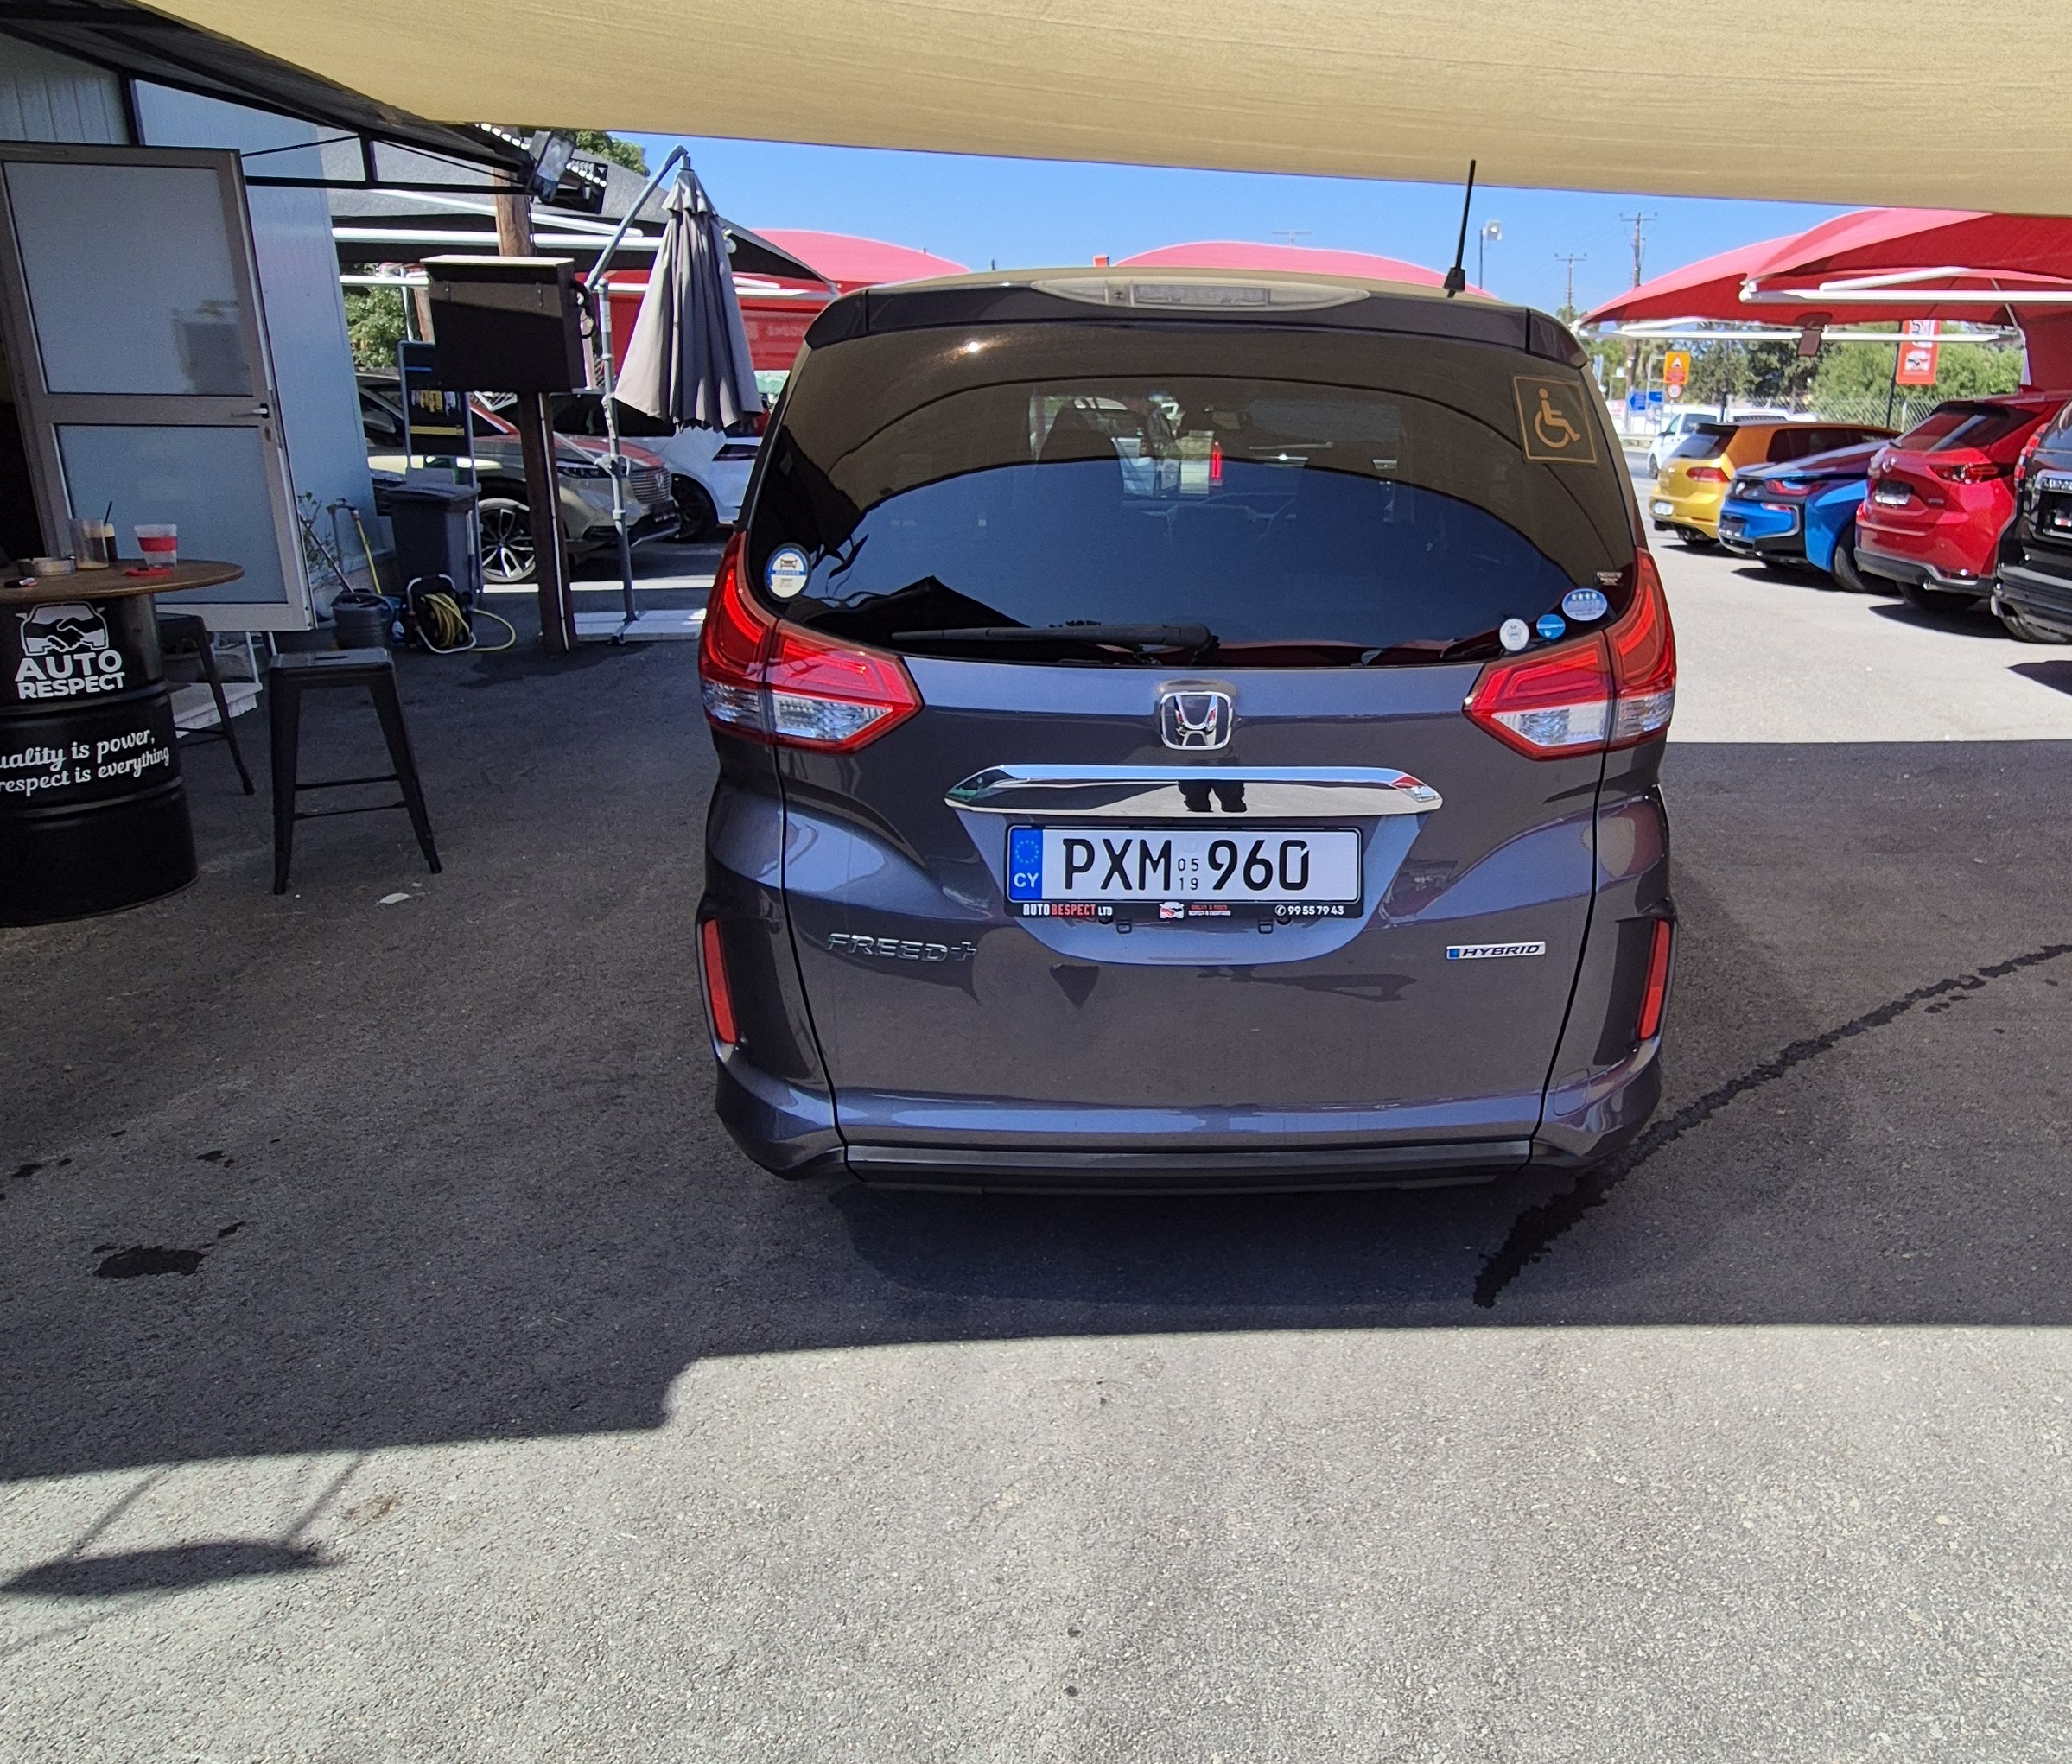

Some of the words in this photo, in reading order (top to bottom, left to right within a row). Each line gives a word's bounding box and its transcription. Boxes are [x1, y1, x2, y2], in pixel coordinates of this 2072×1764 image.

[14, 650, 123, 682] AUTO
[17, 672, 125, 699] RESPECT
[71, 741, 90, 759] is
[97, 729, 156, 764] power,
[75, 767, 92, 783] is
[98, 747, 169, 777] everything
[1014, 872, 1039, 889] CY
[1062, 837, 1172, 891] PXM
[1207, 839, 1310, 892] 960
[1462, 945, 1540, 956] HYBRID
